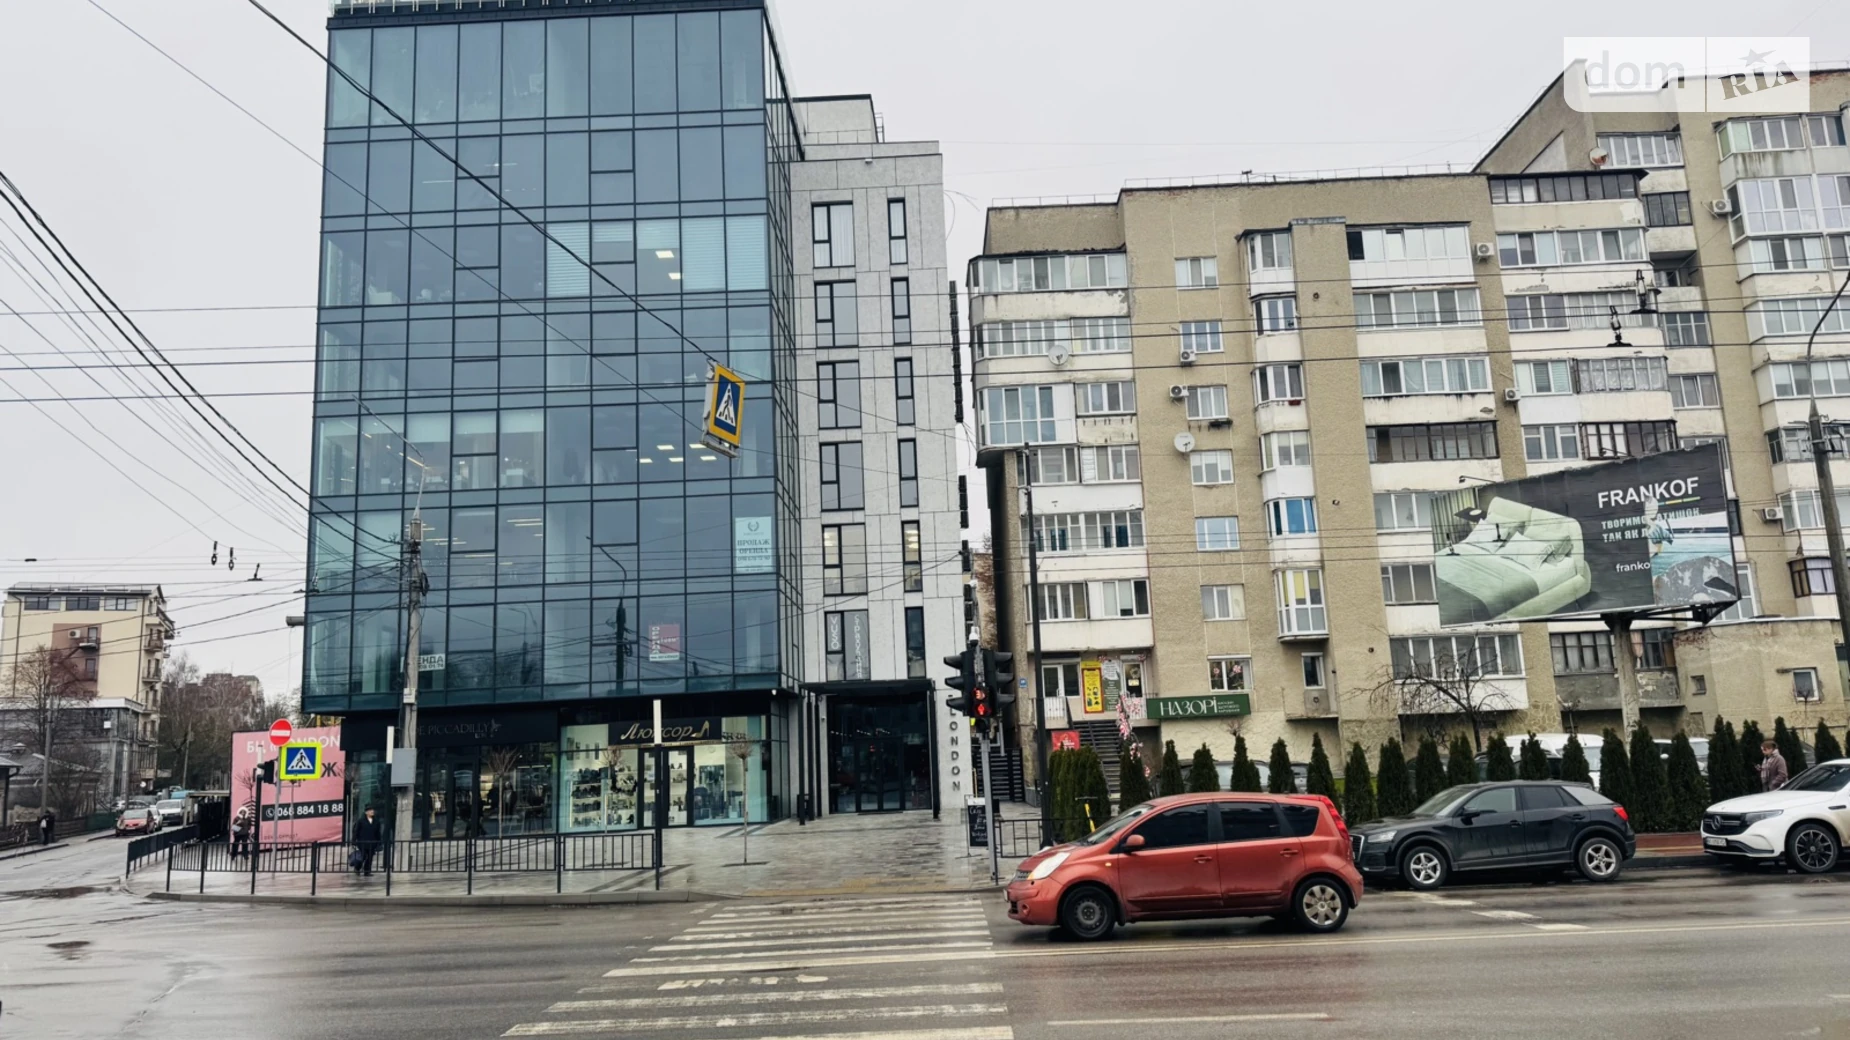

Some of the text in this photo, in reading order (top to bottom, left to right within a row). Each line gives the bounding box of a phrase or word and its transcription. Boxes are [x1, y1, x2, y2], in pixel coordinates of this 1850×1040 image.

[1597, 476, 1699, 509] FRANKOF
[1602, 531, 1623, 543] ТАК
[1624, 529, 1640, 540] ЯК
[830, 616, 840, 650] VUSO
[620, 723, 693, 741] Люсор
[297, 805, 314, 816] 884
[317, 804, 329, 814] 18
[331, 803, 344, 813] 88
